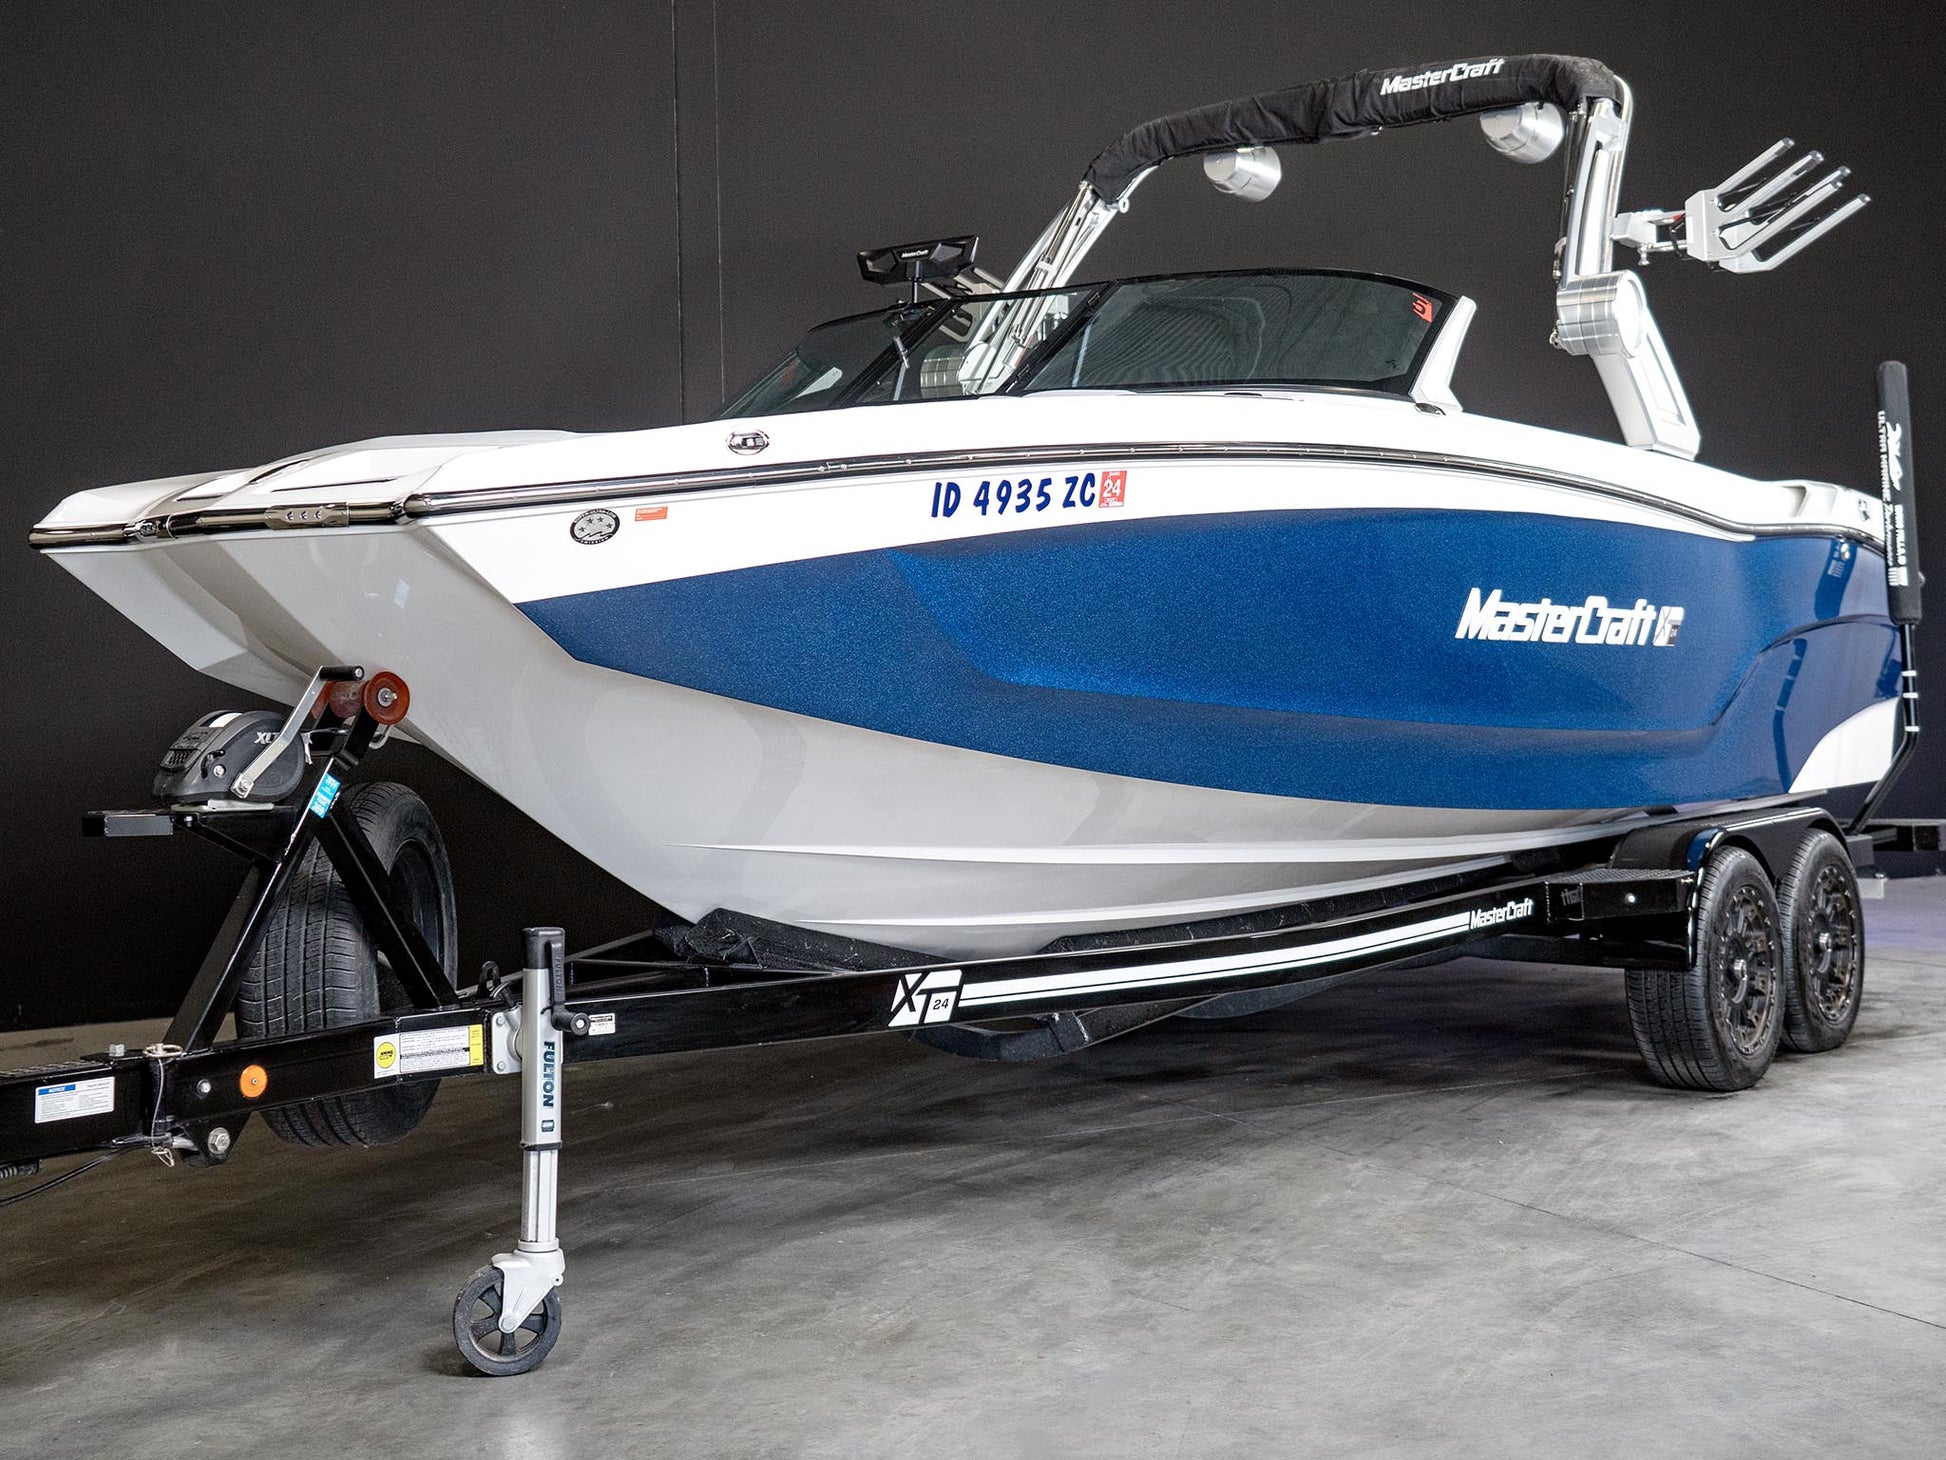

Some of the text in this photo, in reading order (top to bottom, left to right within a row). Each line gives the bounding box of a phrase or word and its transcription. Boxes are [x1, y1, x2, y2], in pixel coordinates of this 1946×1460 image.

[1380, 58, 1505, 96] MasterCraft
[1877, 410, 1888, 453] ULTRA
[931, 472, 1096, 518] ID 4935 ZC
[1102, 479, 1122, 498] 24
[1880, 454, 1892, 502] MARINE
[1454, 587, 1657, 646] MasterCraft
[1470, 897, 1534, 930] MasterCraft
[887, 969, 963, 1027] XT
[932, 998, 949, 1011] 24
[542, 1041, 555, 1108] FULTON
